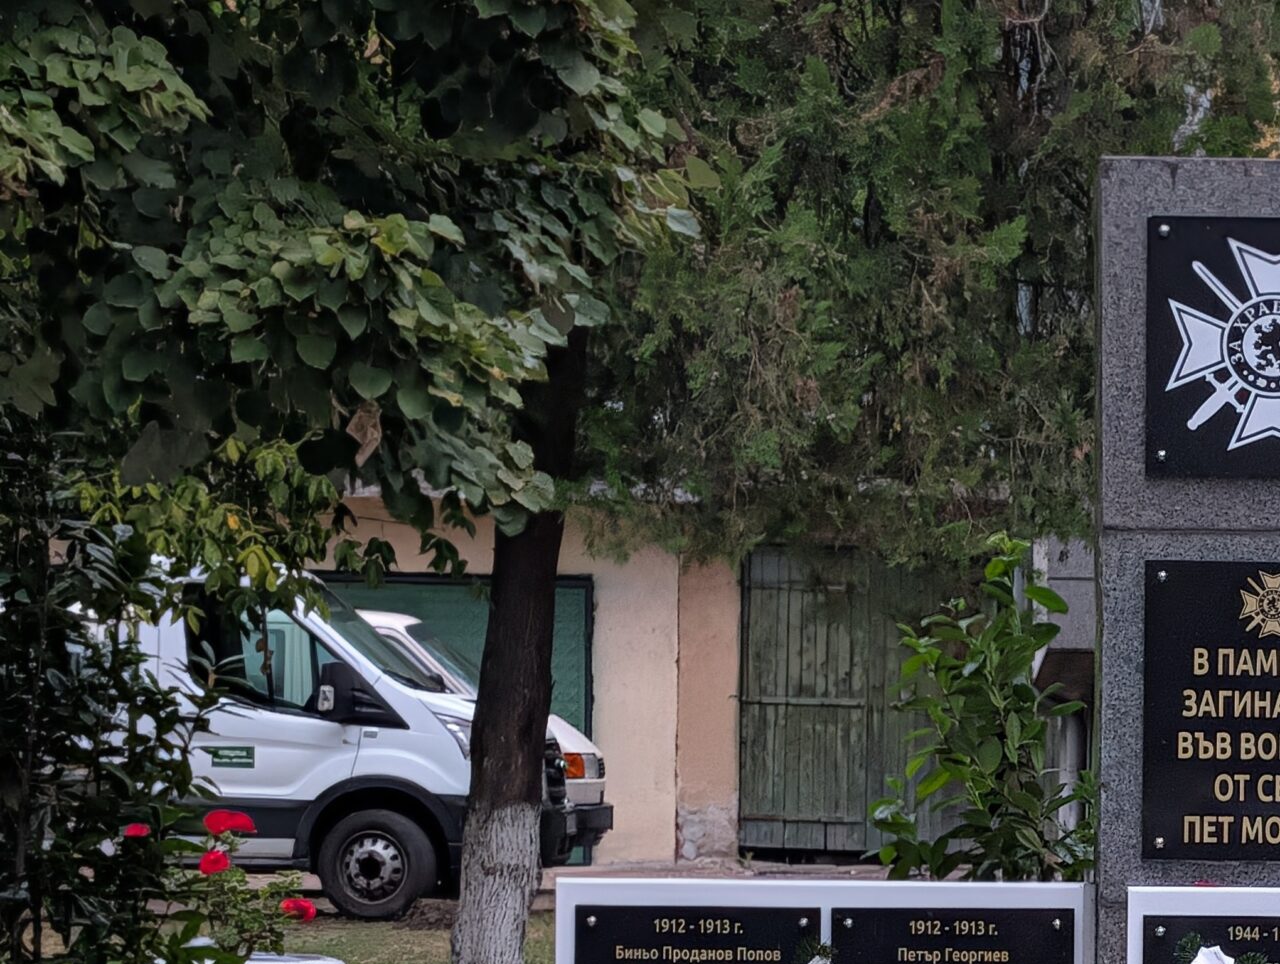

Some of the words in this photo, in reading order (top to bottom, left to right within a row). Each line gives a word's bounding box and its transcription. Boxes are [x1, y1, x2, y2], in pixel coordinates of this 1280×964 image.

[1229, 340, 1244, 365] ЗА
[1193, 648, 1209, 675] В
[1177, 731, 1232, 760] ВЪВ
[1214, 773, 1250, 802] ОТ
[1183, 815, 1234, 843] ПЕТ
[654, 918, 686, 933] 1912
[699, 919, 730, 934] 1913
[734, 921, 744, 934] г.
[909, 920, 941, 934] 1912
[954, 921, 985, 935] 1913
[989, 923, 998, 935] г.
[1228, 926, 1259, 940] 1944
[615, 945, 658, 960] Биньо
[663, 946, 733, 963] Проданов
[737, 947, 781, 961] Попов
[898, 948, 941, 964] Петър
[945, 948, 1009, 964] Георгиев
